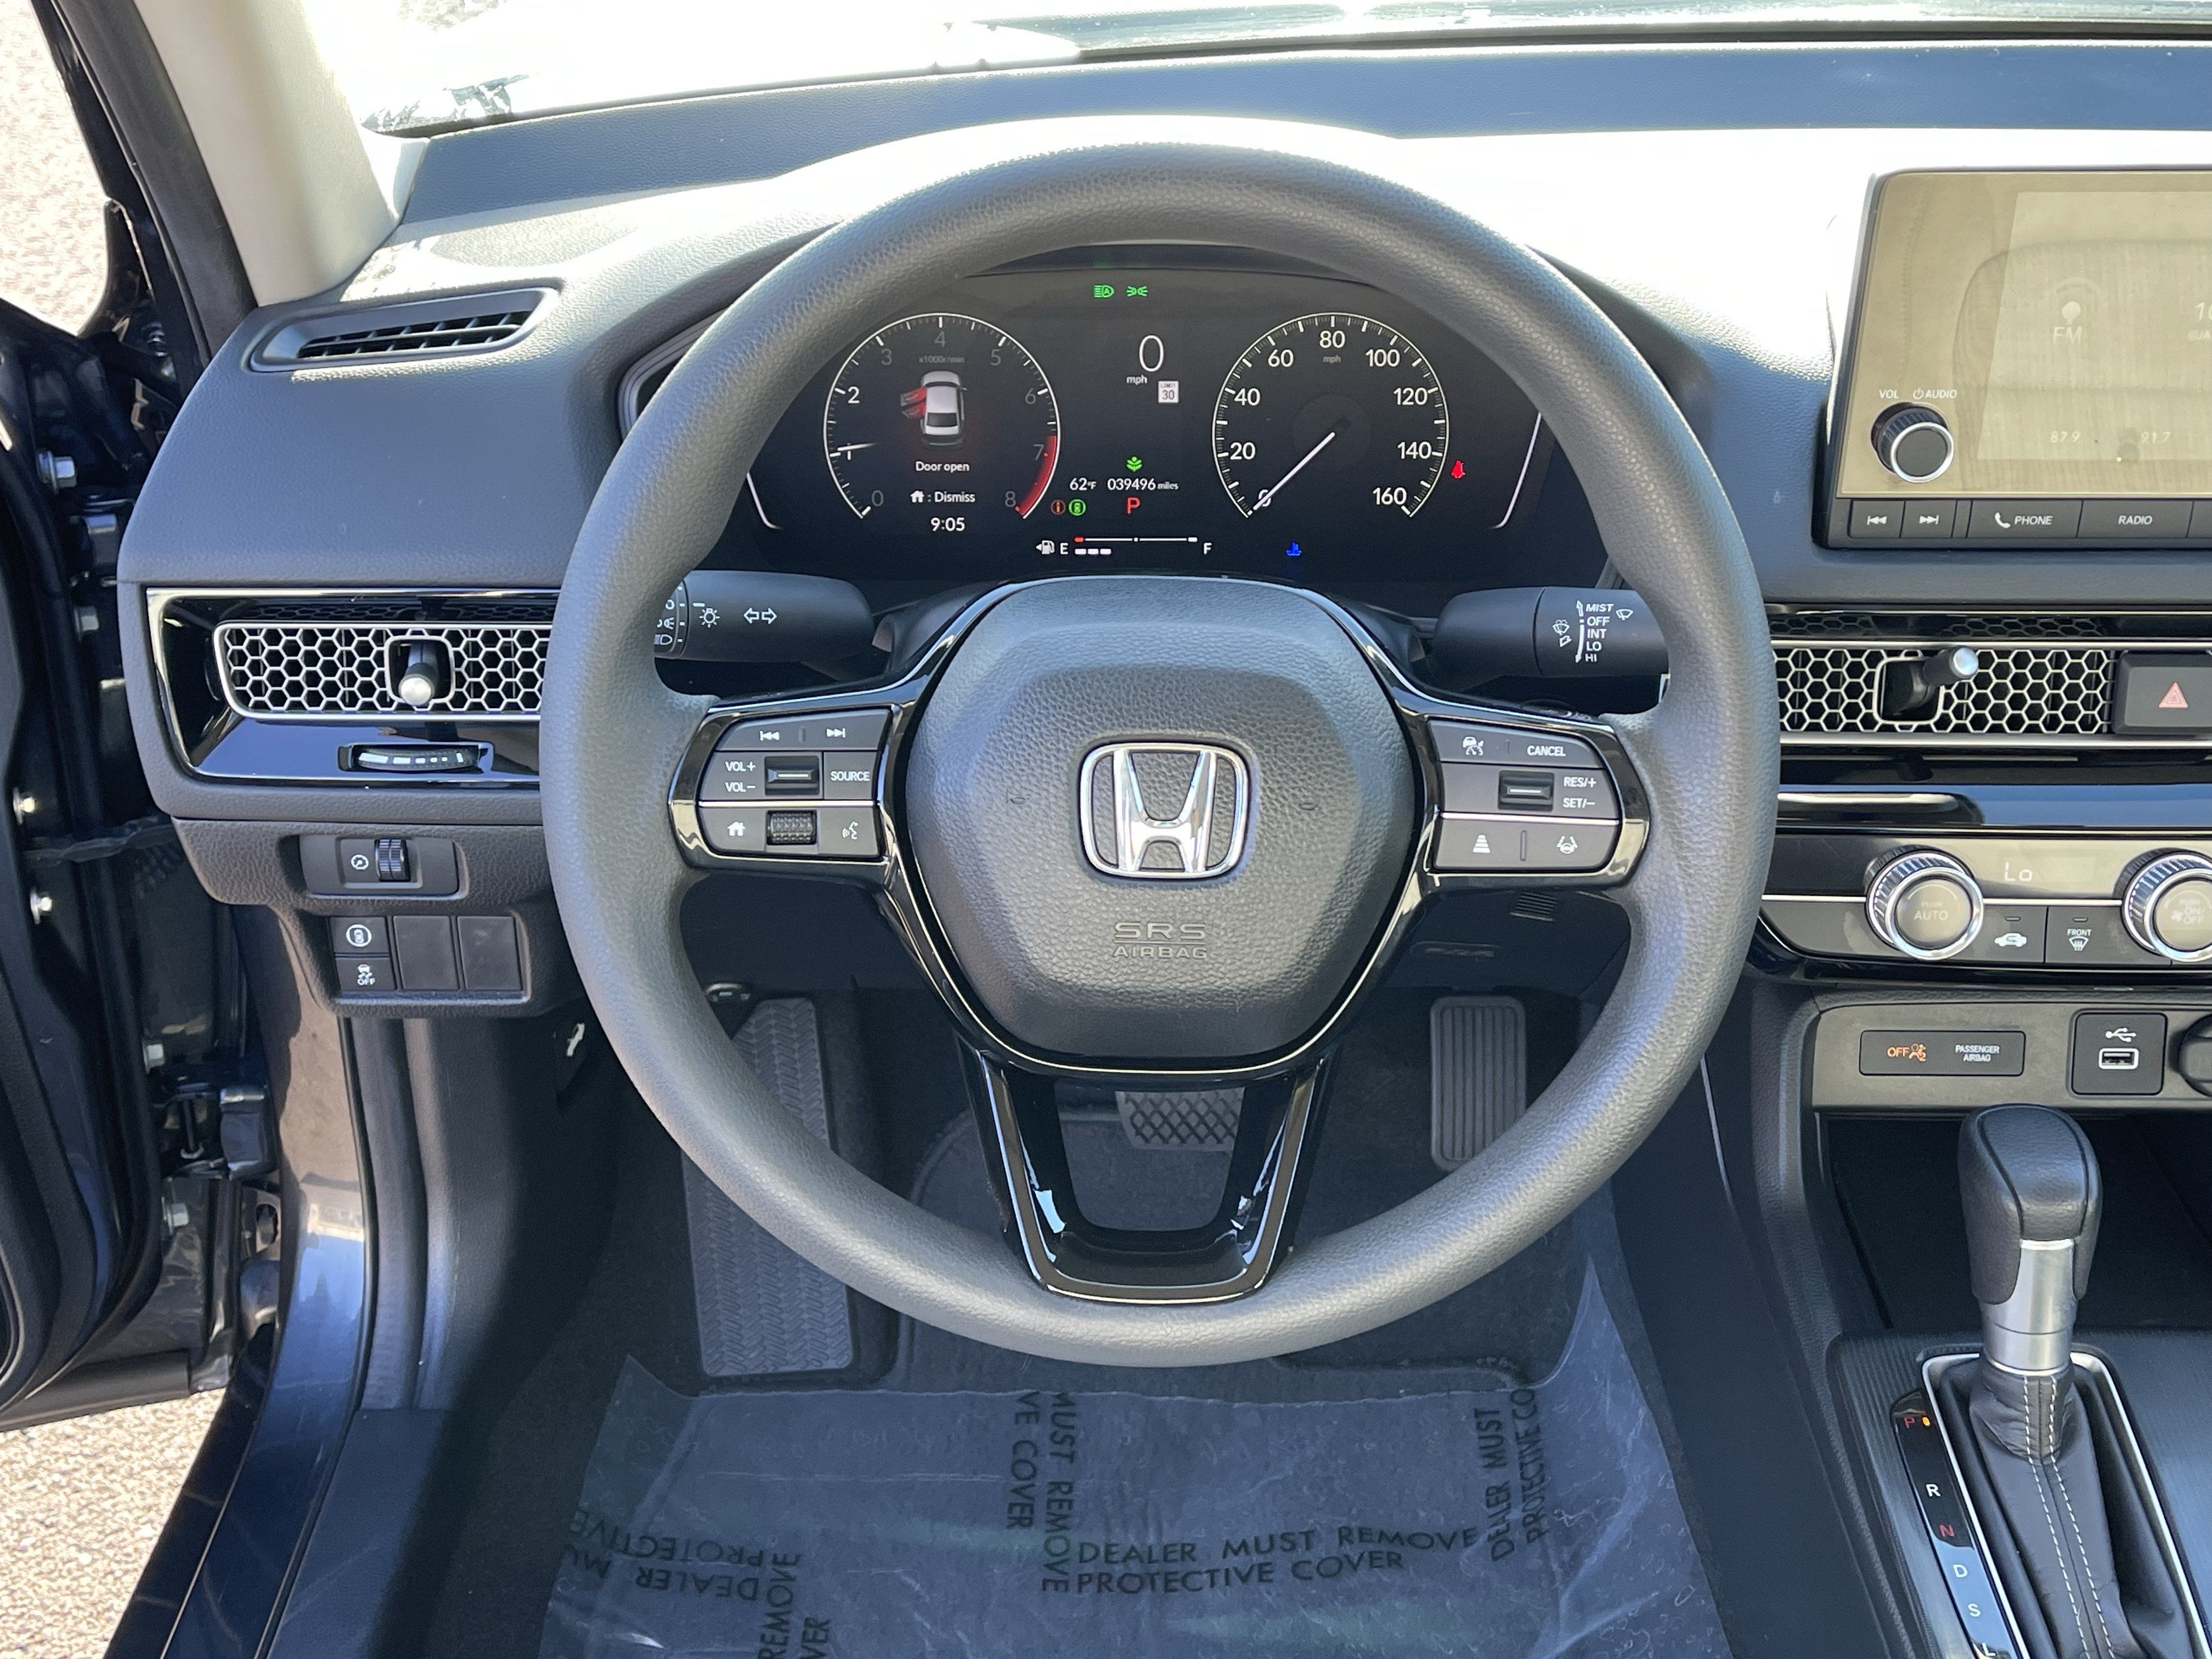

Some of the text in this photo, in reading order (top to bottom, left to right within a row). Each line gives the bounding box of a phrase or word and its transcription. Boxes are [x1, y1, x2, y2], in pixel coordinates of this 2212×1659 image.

[934, 332, 946, 347] 4
[1319, 330, 1345, 348] 80
[2052, 326, 2083, 345] FM
[882, 349, 893, 365] 3
[991, 349, 1002, 366] 5
[1139, 335, 1164, 371] 0
[1268, 349, 1294, 367] 60
[1323, 355, 1341, 364] mph
[1365, 349, 1400, 367] 100
[1126, 375, 1148, 385] mph
[848, 386, 860, 404] 2
[1025, 387, 1036, 404] 6
[1162, 390, 1175, 400] 30
[1234, 388, 1260, 405] 40
[1393, 387, 1427, 405] 120
[1879, 390, 1957, 399] VOL AUDIO
[1032, 443, 1044, 461] 7
[1230, 442, 1256, 459] 20
[1397, 442, 1432, 459] 140
[915, 461, 970, 475] Door open
[1107, 478, 1156, 490] 039496
[1158, 482, 1179, 490] miles
[872, 490, 884, 507] 0
[934, 492, 975, 503] Dismiss
[1005, 491, 1017, 507] 8
[1373, 487, 1407, 505] 160
[1127, 497, 1141, 515] P
[930, 517, 966, 532] 9:05
[2014, 515, 2053, 526] PHONE
[2118, 515, 2153, 525] RADIO
[1060, 543, 1068, 555] E
[1203, 542, 1212, 554] F
[1585, 603, 1614, 612] MIST
[1587, 616, 1610, 627] OFF
[1587, 629, 1606, 639] INT
[1587, 641, 1602, 651] LO
[1585, 653, 1598, 662] HI
[1527, 746, 1566, 757] CANCEL
[831, 771, 870, 781] SOURCE
[1564, 777, 1597, 787] RES/+
[1914, 910, 1948, 920] AUTO
[1114, 922, 1207, 940] SRS
[1113, 945, 1207, 959] AIRBAG
[1887, 1047, 1909, 1057] OFF
[1955, 1045, 2000, 1054] PASSENGER
[1904, 1417, 1915, 1428] P
[1511, 1389, 1550, 1543] PROTECTIVE CO
[1006, 1440, 1039, 1529] COVER
[1474, 1408, 1515, 1562] DEALER MUST
[1926, 1483, 1941, 1497] R
[1042, 1482, 1074, 1592] REMOVE
[1939, 1525, 1955, 1537] N
[1079, 1525, 1479, 1564] DEALER MUST REMOVE
[1078, 1551, 1403, 1594] PROTECTIVE COVER
[1953, 1564, 1968, 1578] D
[635, 1566, 759, 1601] DEALER
[1968, 1603, 1981, 1617] S
[1982, 1642, 1996, 1657] L
